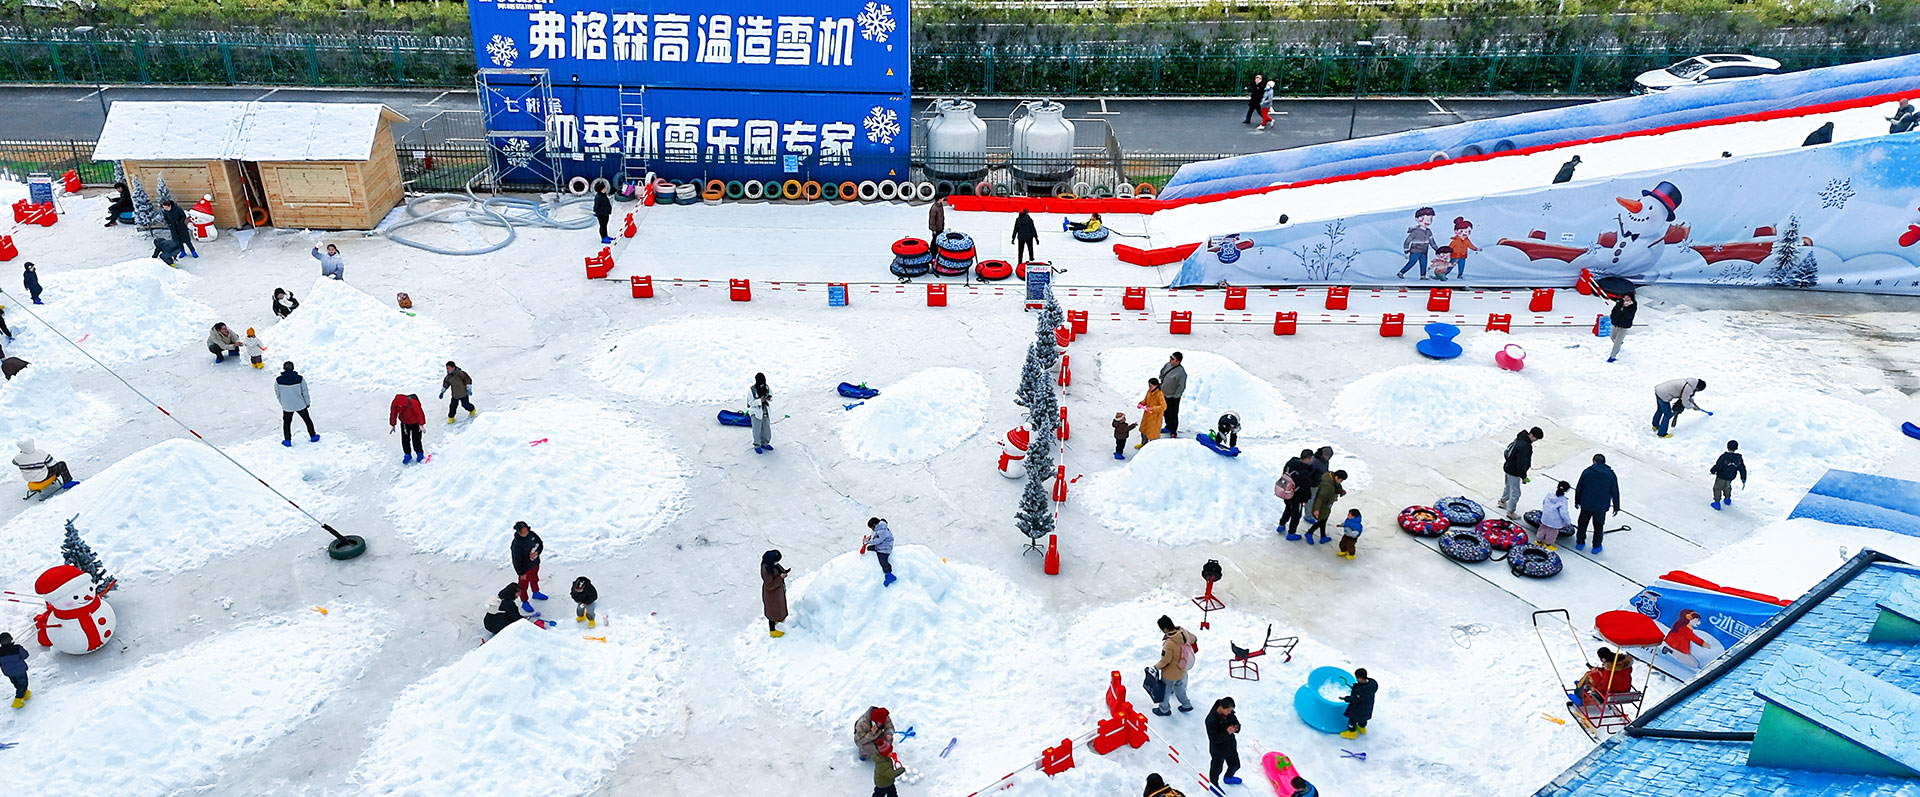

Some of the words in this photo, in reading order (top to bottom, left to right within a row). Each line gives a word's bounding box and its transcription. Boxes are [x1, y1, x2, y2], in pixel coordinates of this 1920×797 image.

[529, 11, 855, 66] 弗格森高温造雪机
[545, 114, 856, 166] 四季冰雪乐园专家
